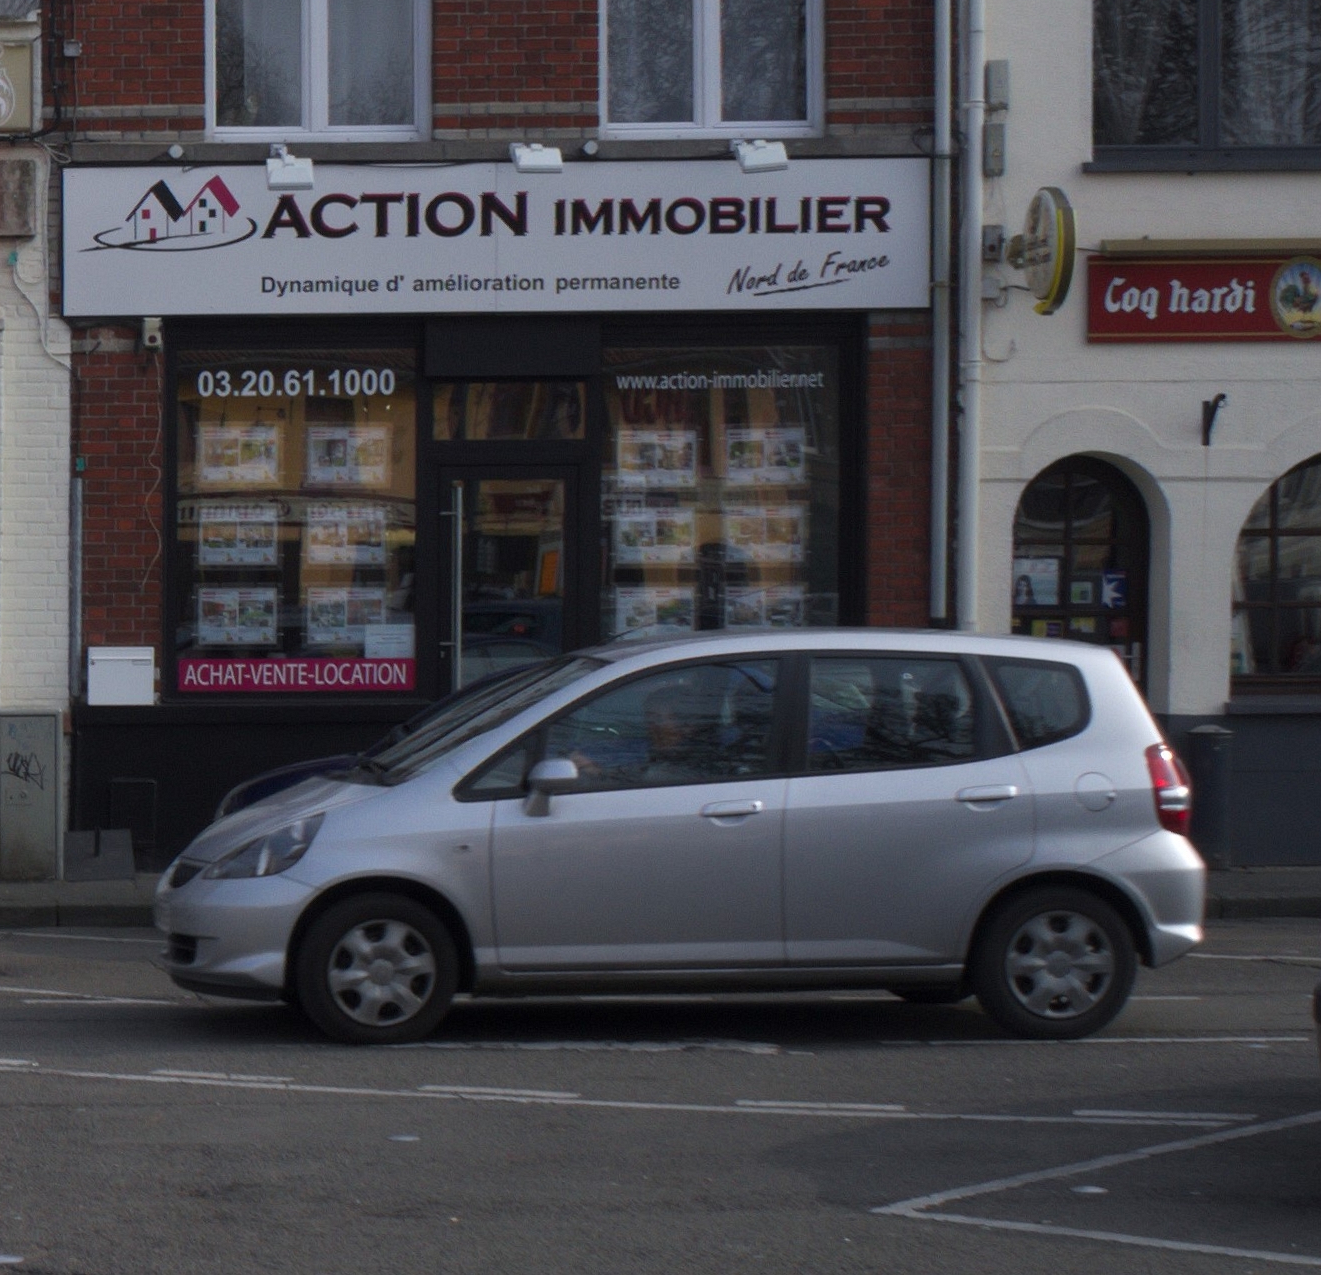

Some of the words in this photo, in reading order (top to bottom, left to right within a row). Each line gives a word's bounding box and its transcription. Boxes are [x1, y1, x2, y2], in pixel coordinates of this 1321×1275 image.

[261, 191, 530, 240] ACTION
[554, 196, 892, 236] IMMOBILIER
[261, 274, 379, 297] Dynamique
[413, 272, 545, 292] amélioration
[556, 274, 681, 294] permanente
[726, 265, 781, 295] Nord
[786, 263, 809, 284] de
[819, 252, 891, 276] France
[1104, 276, 1159, 320] Coq
[1168, 277, 1256, 314] hardi
[197, 368, 396, 397] 03.20.61.1000
[616, 369, 825, 390] www.action-immobilier.net
[183, 662, 407, 686] ACHAT-VENTE-LOCATION
